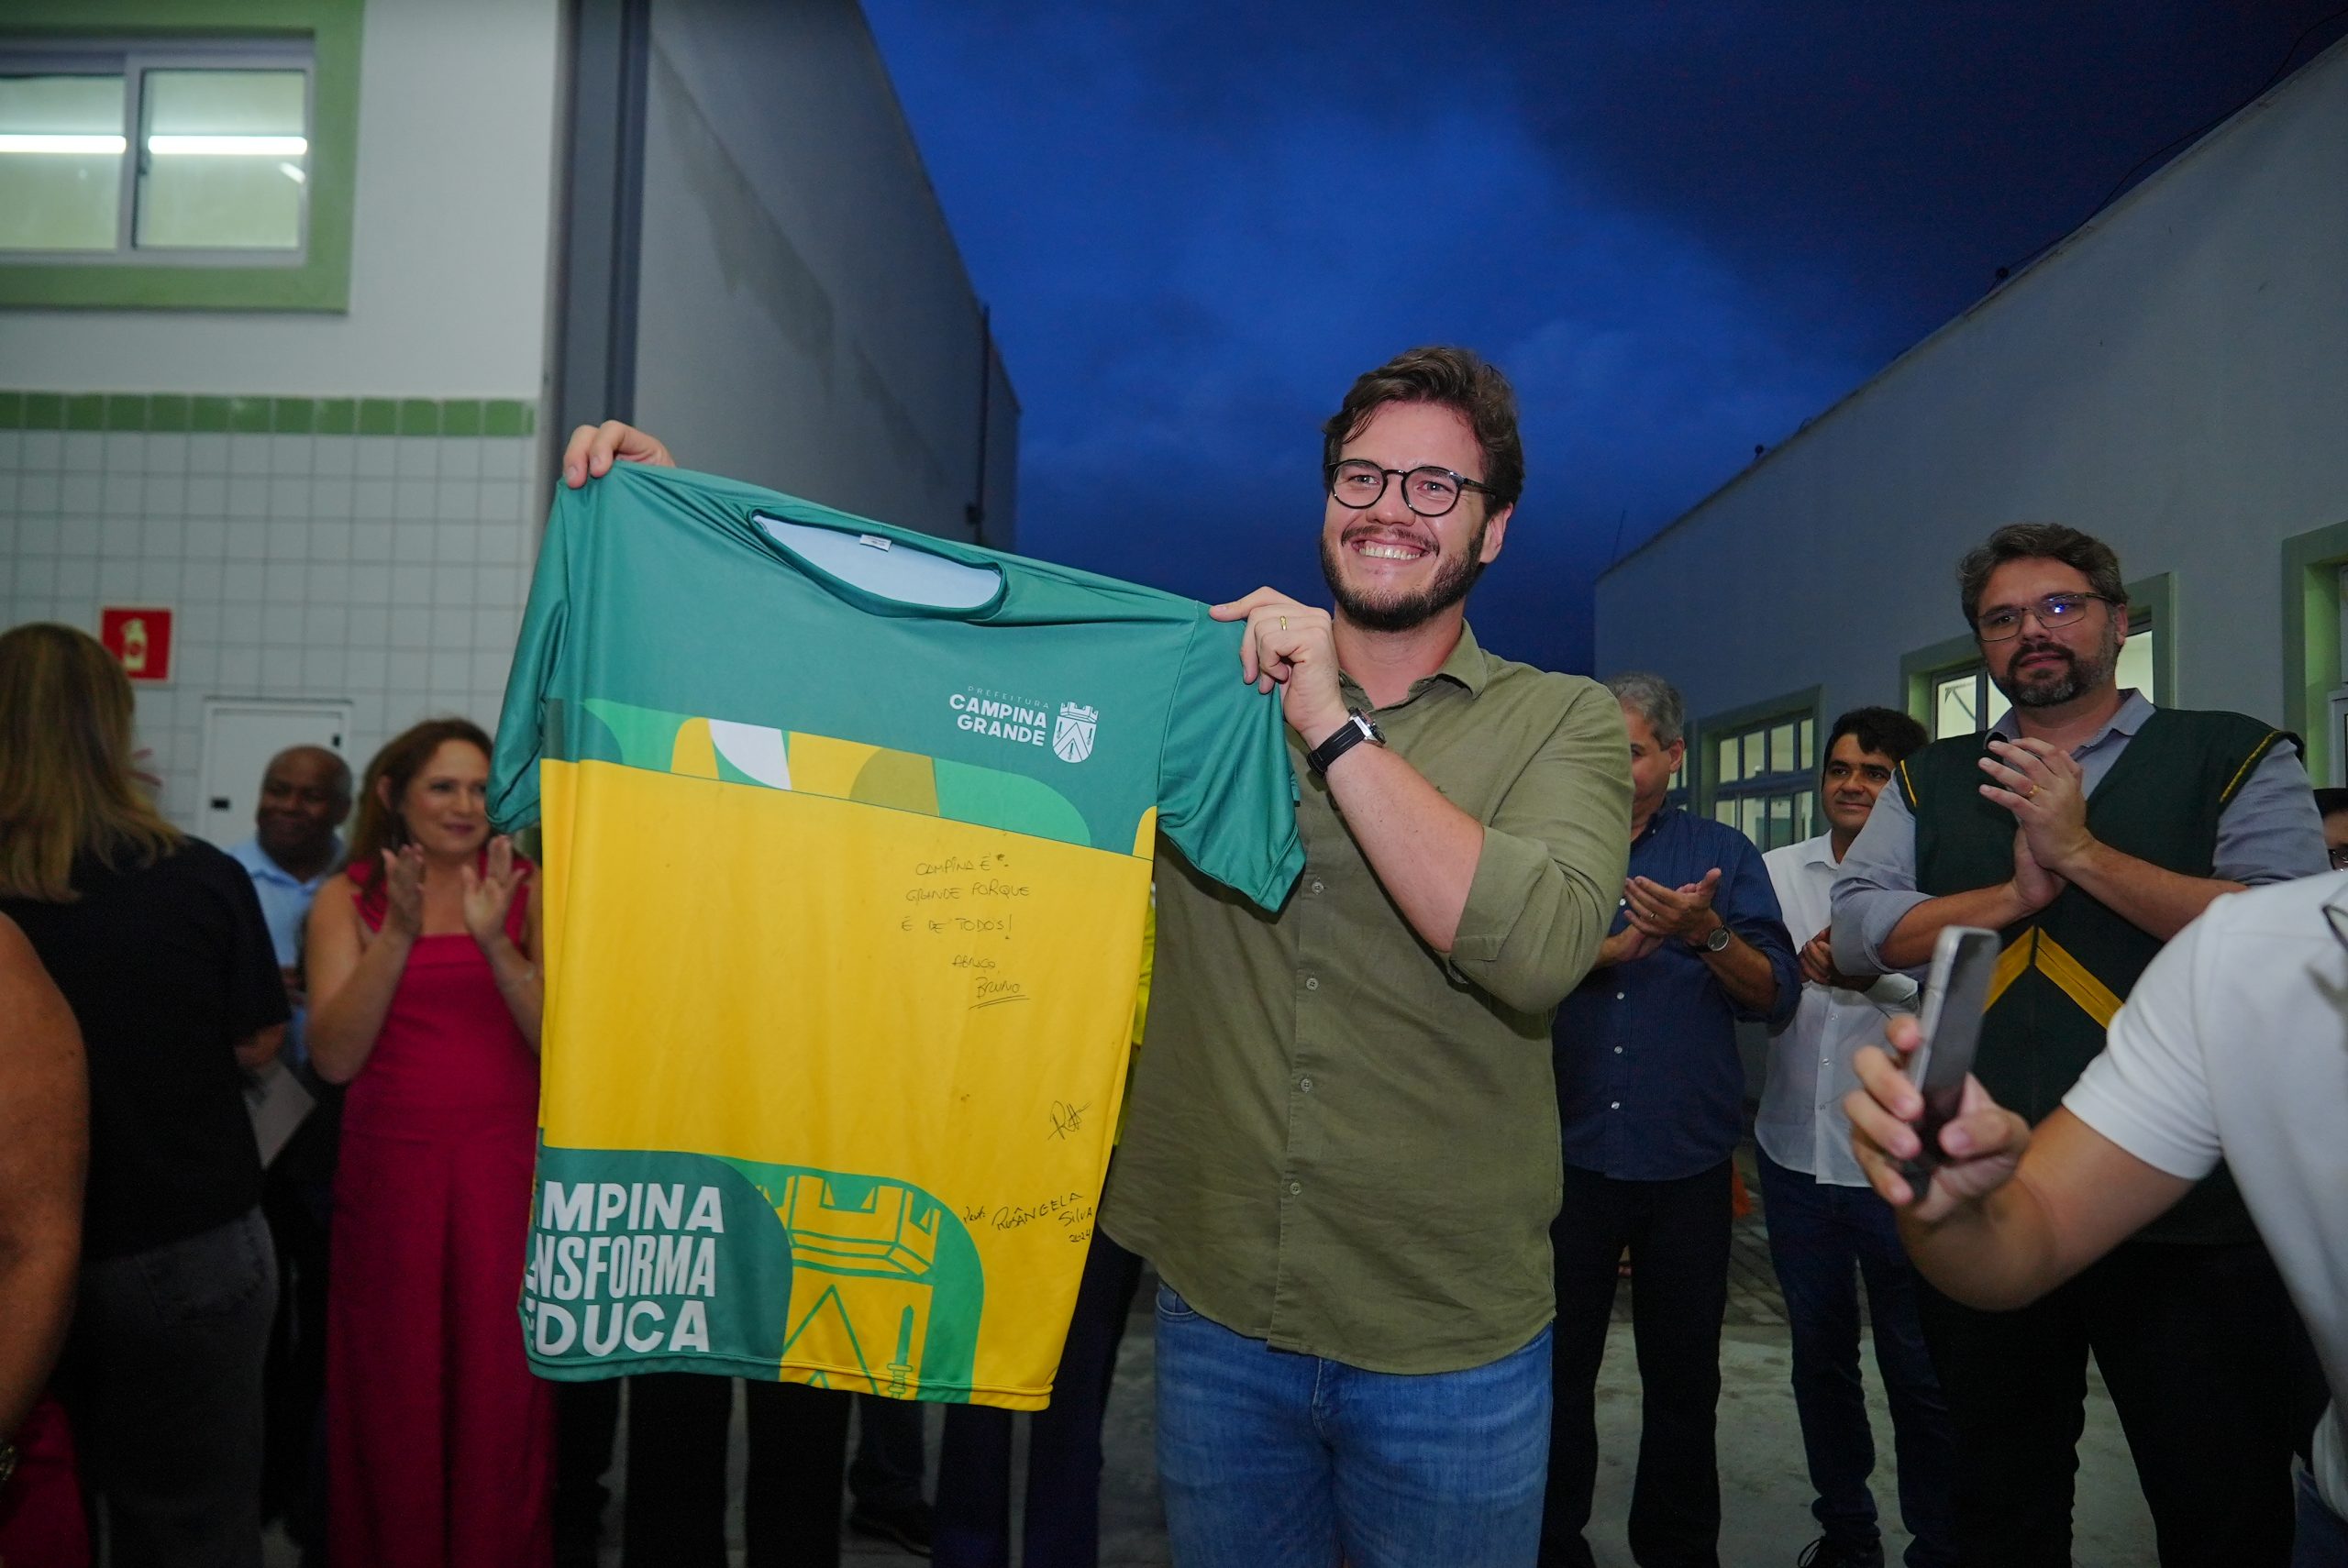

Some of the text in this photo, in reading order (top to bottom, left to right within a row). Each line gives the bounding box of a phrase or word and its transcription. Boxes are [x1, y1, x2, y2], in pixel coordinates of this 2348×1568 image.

[968, 686, 1049, 709] PREFEITURA
[949, 694, 1047, 728] CAMPINA
[957, 714, 1046, 747] GRANDE
[915, 856, 977, 876] CAMPINA
[971, 878, 1030, 900] PORQUE
[928, 919, 947, 934] DE
[537, 1180, 725, 1233] MPINA
